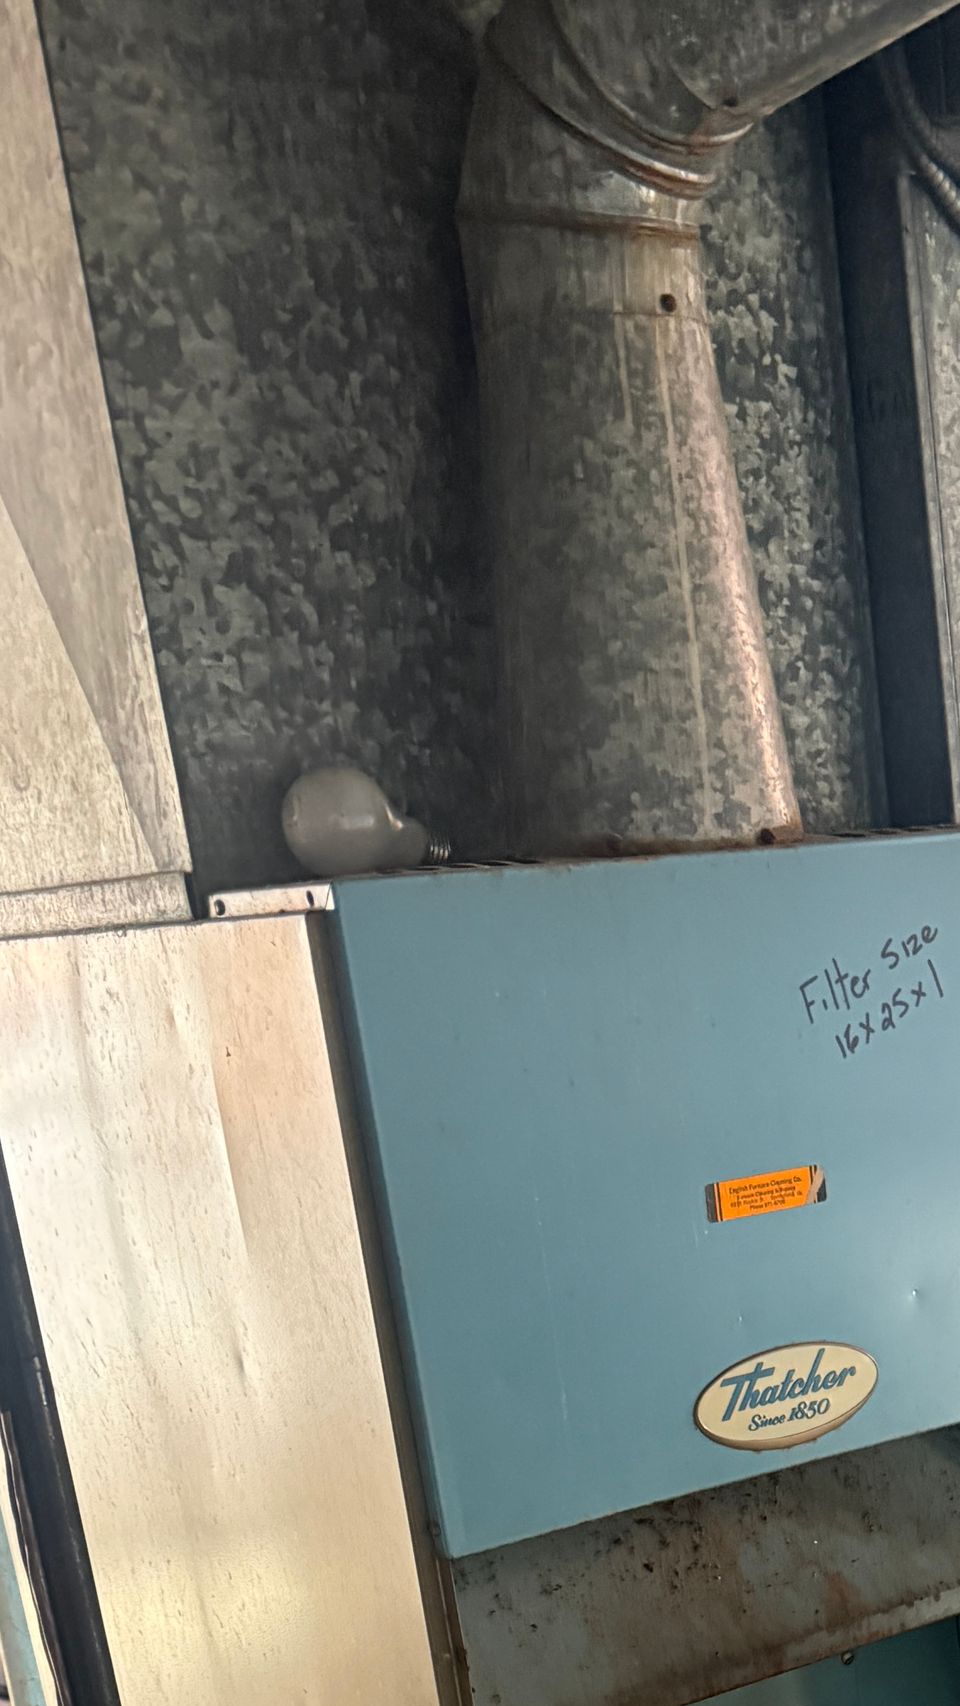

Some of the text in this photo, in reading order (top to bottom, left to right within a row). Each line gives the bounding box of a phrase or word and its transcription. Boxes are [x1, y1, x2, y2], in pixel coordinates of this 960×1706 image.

[799, 925, 939, 1025] Filter Size
[720, 1348, 856, 1422] Thatcher
[748, 1398, 830, 1432] Since 1850
